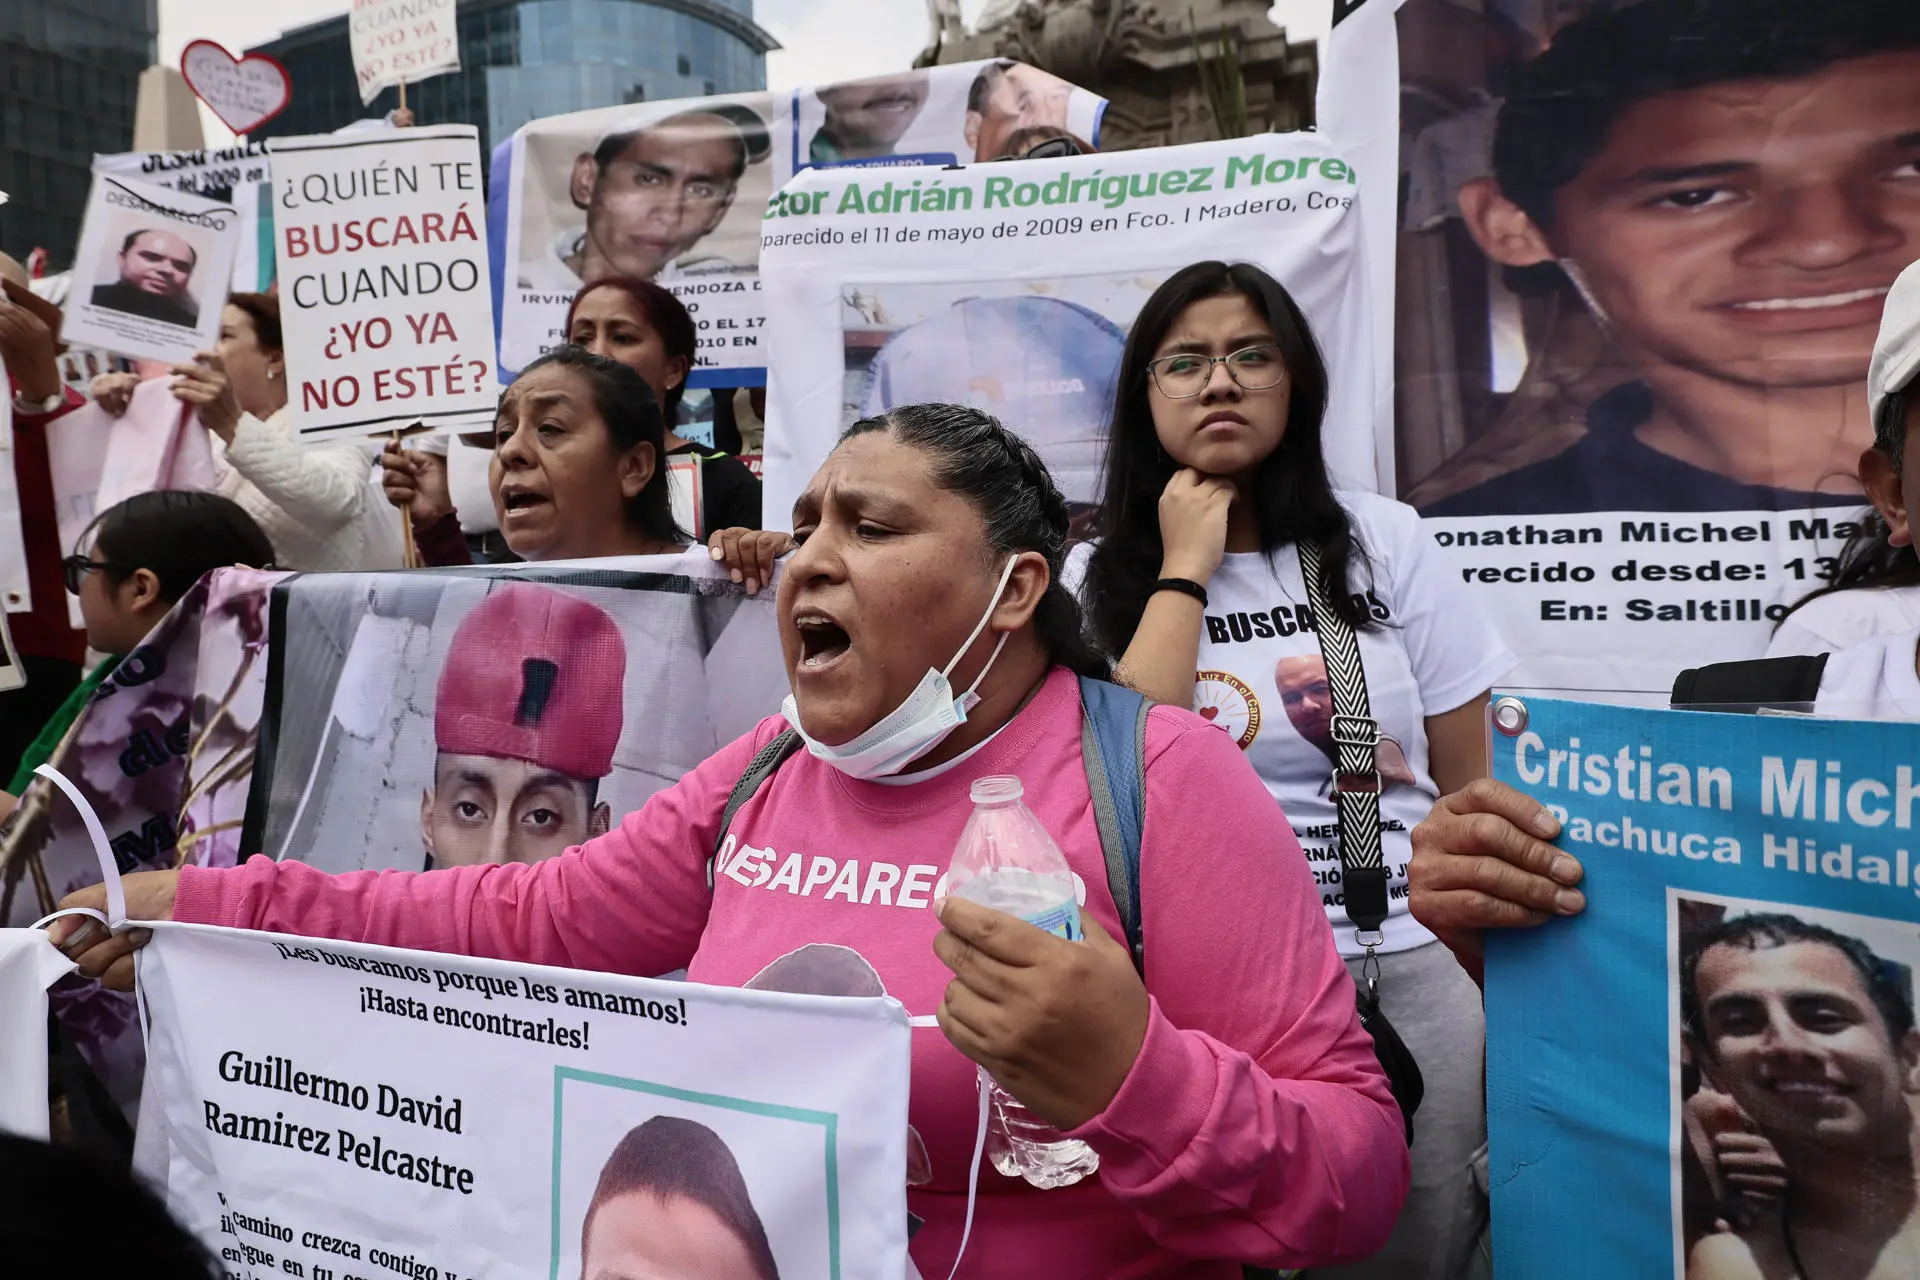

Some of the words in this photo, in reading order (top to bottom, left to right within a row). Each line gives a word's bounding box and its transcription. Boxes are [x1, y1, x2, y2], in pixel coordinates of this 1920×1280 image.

[413, 20, 437, 38] YA
[282, 160, 418, 209] ¿QUIÉN
[430, 162, 474, 191] TE
[837, 180, 972, 215] Adrián
[984, 166, 1215, 209] Rodríguez
[285, 202, 478, 258] BUSCARÁ
[851, 227, 868, 244] el
[875, 227, 889, 244] 11
[895, 226, 921, 243] de
[928, 227, 984, 245] mayo
[992, 222, 1018, 240] de
[1026, 217, 1083, 237] 2009
[1090, 218, 1118, 232] en
[1127, 211, 1175, 229] Fco.
[1199, 197, 1297, 222] Madero,
[293, 259, 478, 309] CUANDO
[324, 317, 392, 360] ¿YO
[405, 312, 458, 345] YA
[717, 318, 739, 329] EL
[733, 336, 757, 346] EN
[302, 375, 360, 412] NO
[373, 354, 488, 402] ESTÉ?
[1620, 520, 1770, 543] Michel
[1611, 559, 1766, 582] desde:
[1541, 600, 1607, 620] En:
[1625, 599, 1788, 622] Saltillo
[1199, 671, 1221, 681] Luz
[1223, 674, 1238, 687] En
[1239, 686, 1253, 701] el
[1243, 699, 1259, 743] Camino
[1515, 731, 1733, 811] Cristian
[1545, 803, 1742, 865] Pachuca
[317, 947, 431, 984] buscamos
[433, 968, 518, 1000] porque
[519, 976, 559, 1004] les
[564, 988, 688, 1026] amamos!
[360, 986, 428, 1022] ¡Hasta
[433, 1004, 589, 1050] encontrarles!
[218, 1050, 369, 1111] Guillermo
[376, 1084, 462, 1134] David
[203, 1099, 331, 1156] Ramirez
[337, 1129, 474, 1195] Pelcastre
[282, 1258, 304, 1278] en
[313, 1264, 333, 1280] tu
[301, 1231, 361, 1260] crezca
[369, 1248, 438, 1280] contigo
